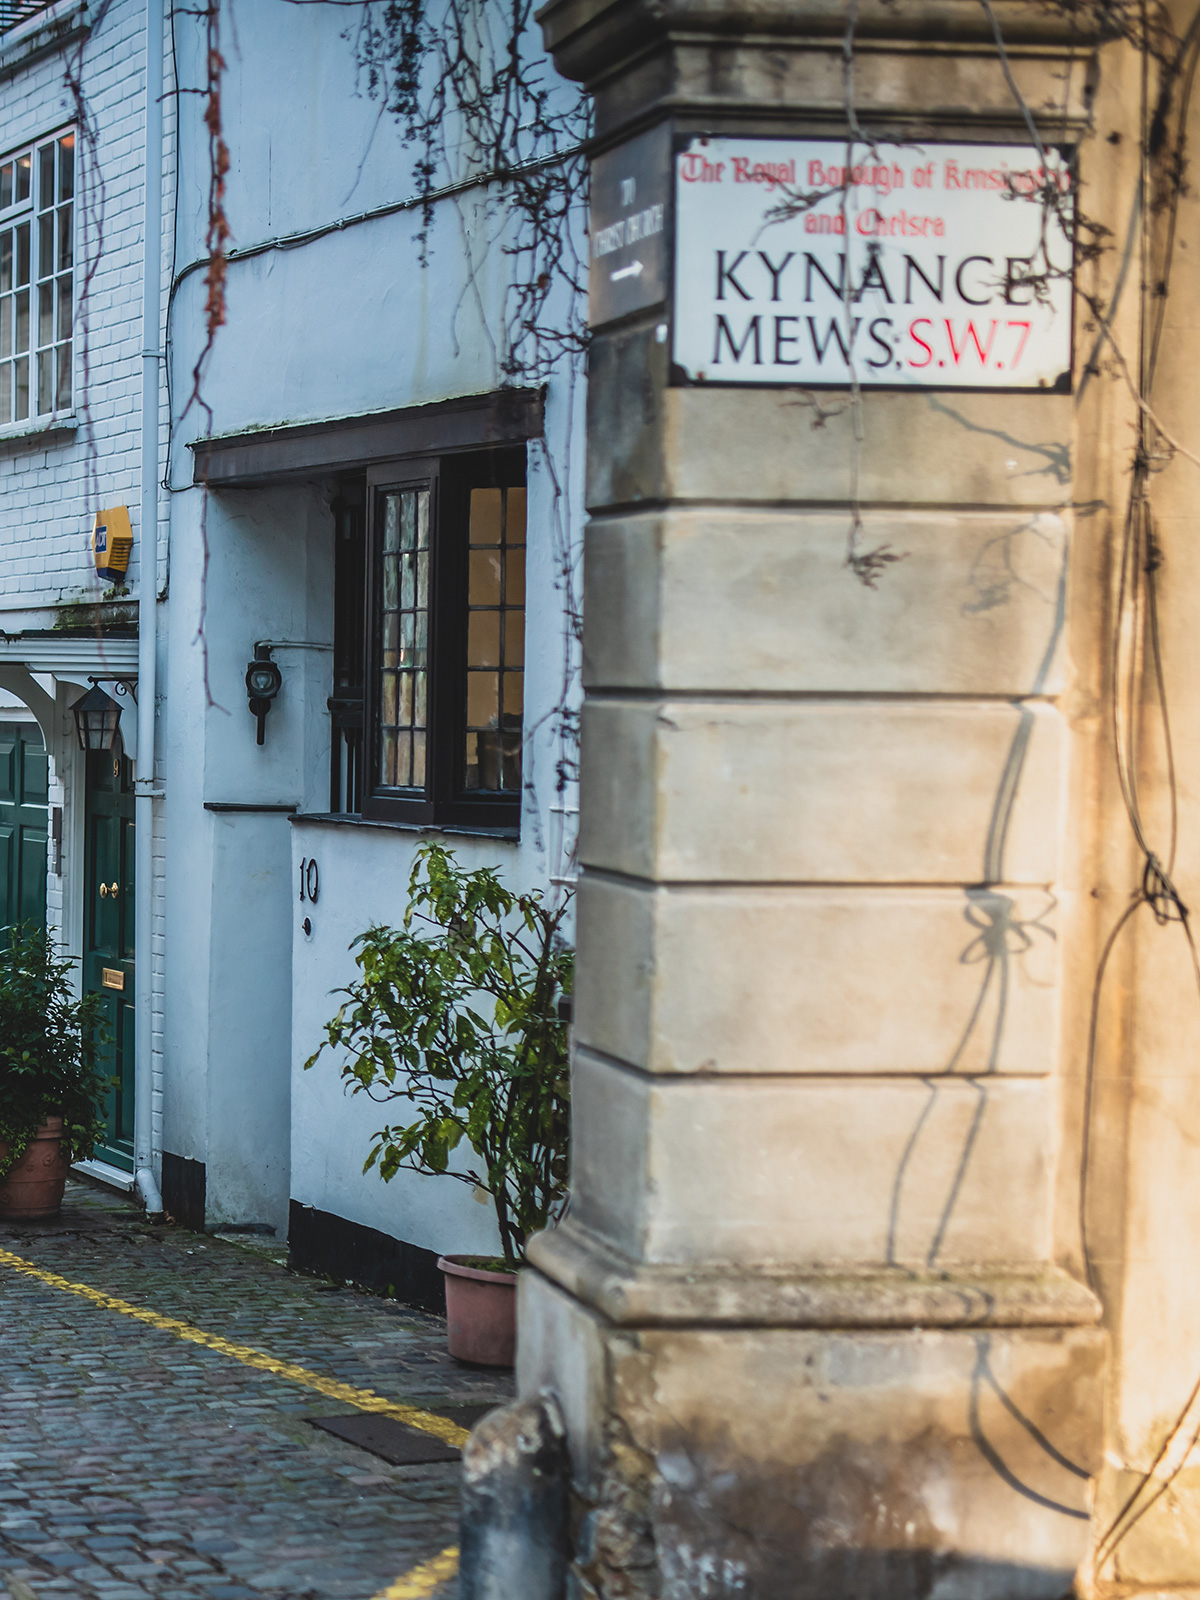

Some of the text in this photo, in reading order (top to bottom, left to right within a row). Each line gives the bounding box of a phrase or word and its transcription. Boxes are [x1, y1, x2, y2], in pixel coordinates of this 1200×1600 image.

[681, 153, 725, 182] The
[731, 157, 796, 192] Royal
[808, 160, 904, 196] Borough
[912, 162, 936, 189] of
[804, 208, 945, 237] and Chelsea
[715, 250, 1032, 306] KYNANCE
[300, 857, 319, 904] 10
